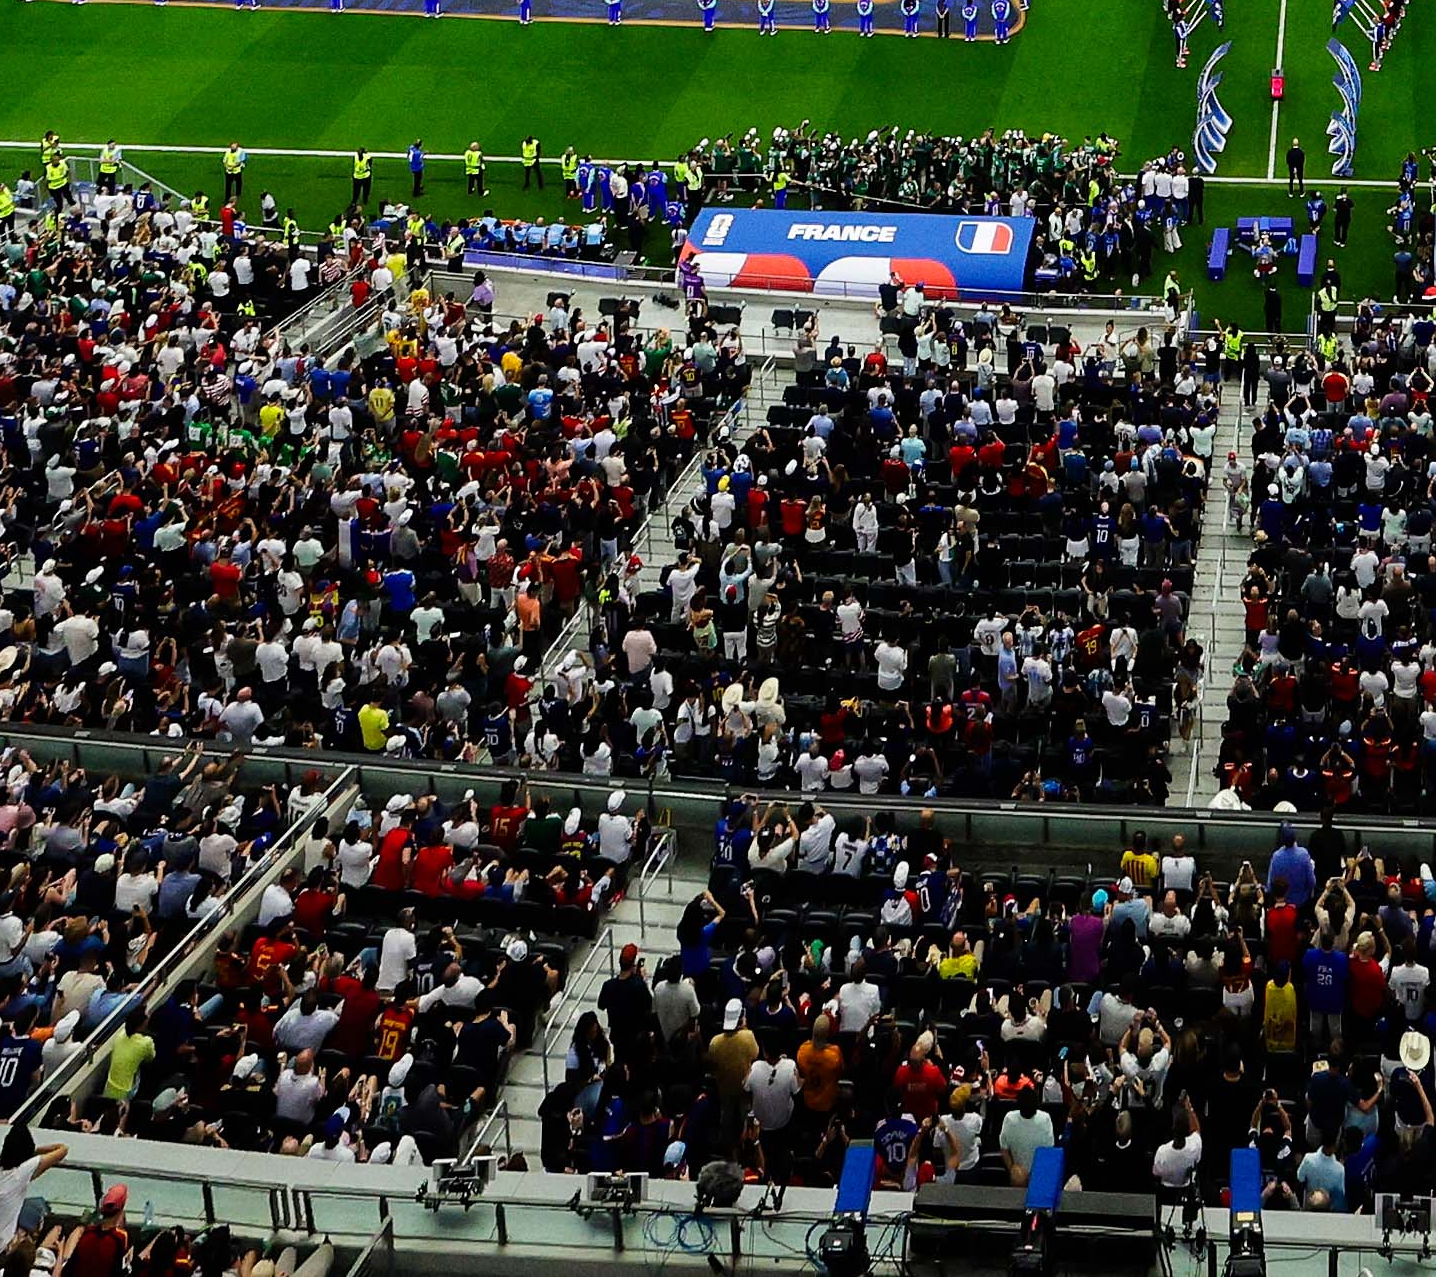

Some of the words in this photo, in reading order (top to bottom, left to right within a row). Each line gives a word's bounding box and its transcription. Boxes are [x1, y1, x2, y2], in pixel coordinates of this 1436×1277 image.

[787, 223, 897, 243] FRANCE
[1096, 530, 1109, 544] 10
[886, 1142, 903, 1163] 10
